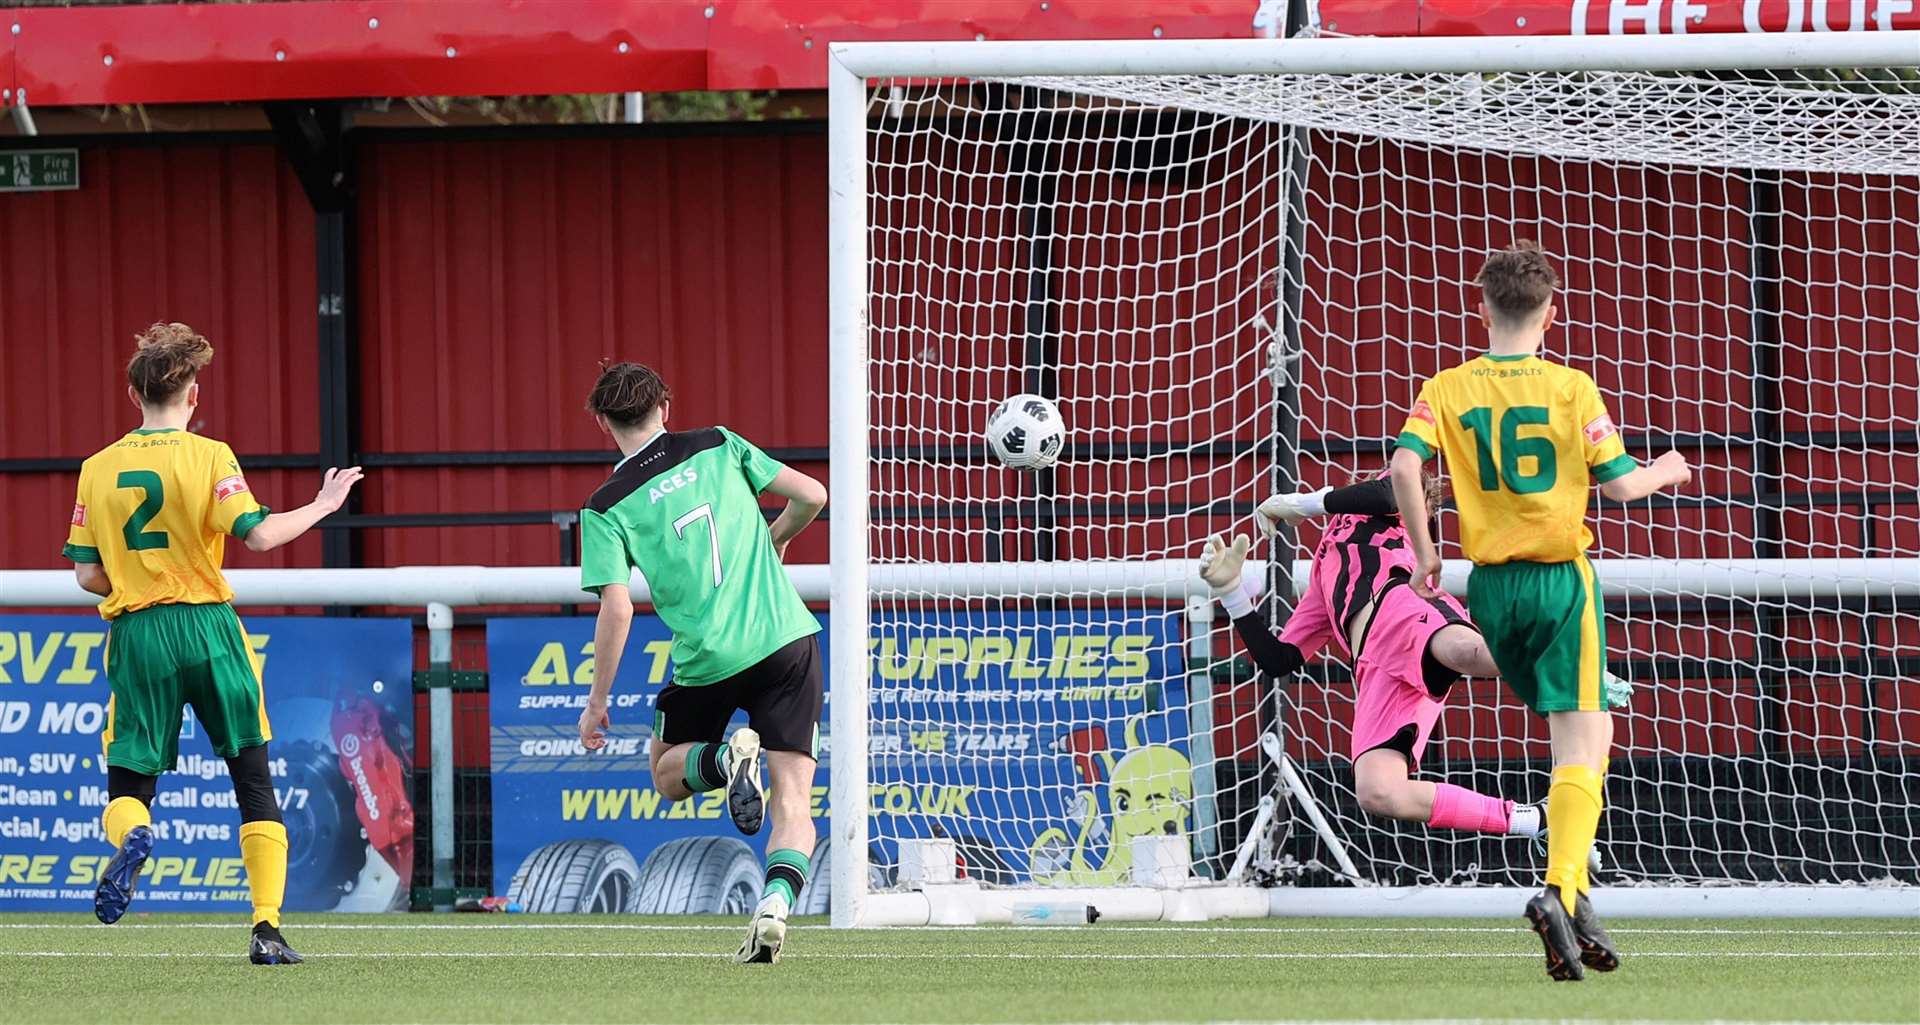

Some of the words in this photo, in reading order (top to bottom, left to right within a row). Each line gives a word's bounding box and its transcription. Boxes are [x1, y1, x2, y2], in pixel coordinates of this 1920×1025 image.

[43, 170, 69, 184] exit
[1510, 367, 1543, 377] BOLTS
[150, 439, 181, 447] BOLTS
[1459, 405, 1557, 495] 16
[648, 466, 698, 505] ACES
[116, 470, 169, 551] 2
[672, 502, 724, 589] 7
[518, 695, 613, 709] SUPPLIE
[616, 694, 642, 708] OF
[1060, 685, 1144, 702] LIMITED
[0, 701, 31, 733] D
[37, 701, 110, 734] MO
[519, 739, 586, 757] GOING
[596, 739, 640, 756] THE
[909, 730, 949, 751] 45
[953, 733, 1032, 751] YEARS
[29, 753, 77, 775] SUV
[158, 786, 199, 808] call
[200, 788, 240, 809] out
[350, 755, 380, 820] brembo
[0, 815, 48, 842] cial,
[171, 818, 232, 845] Tyres
[148, 889, 181, 901] SINCE
[210, 889, 252, 902] LIMIT
